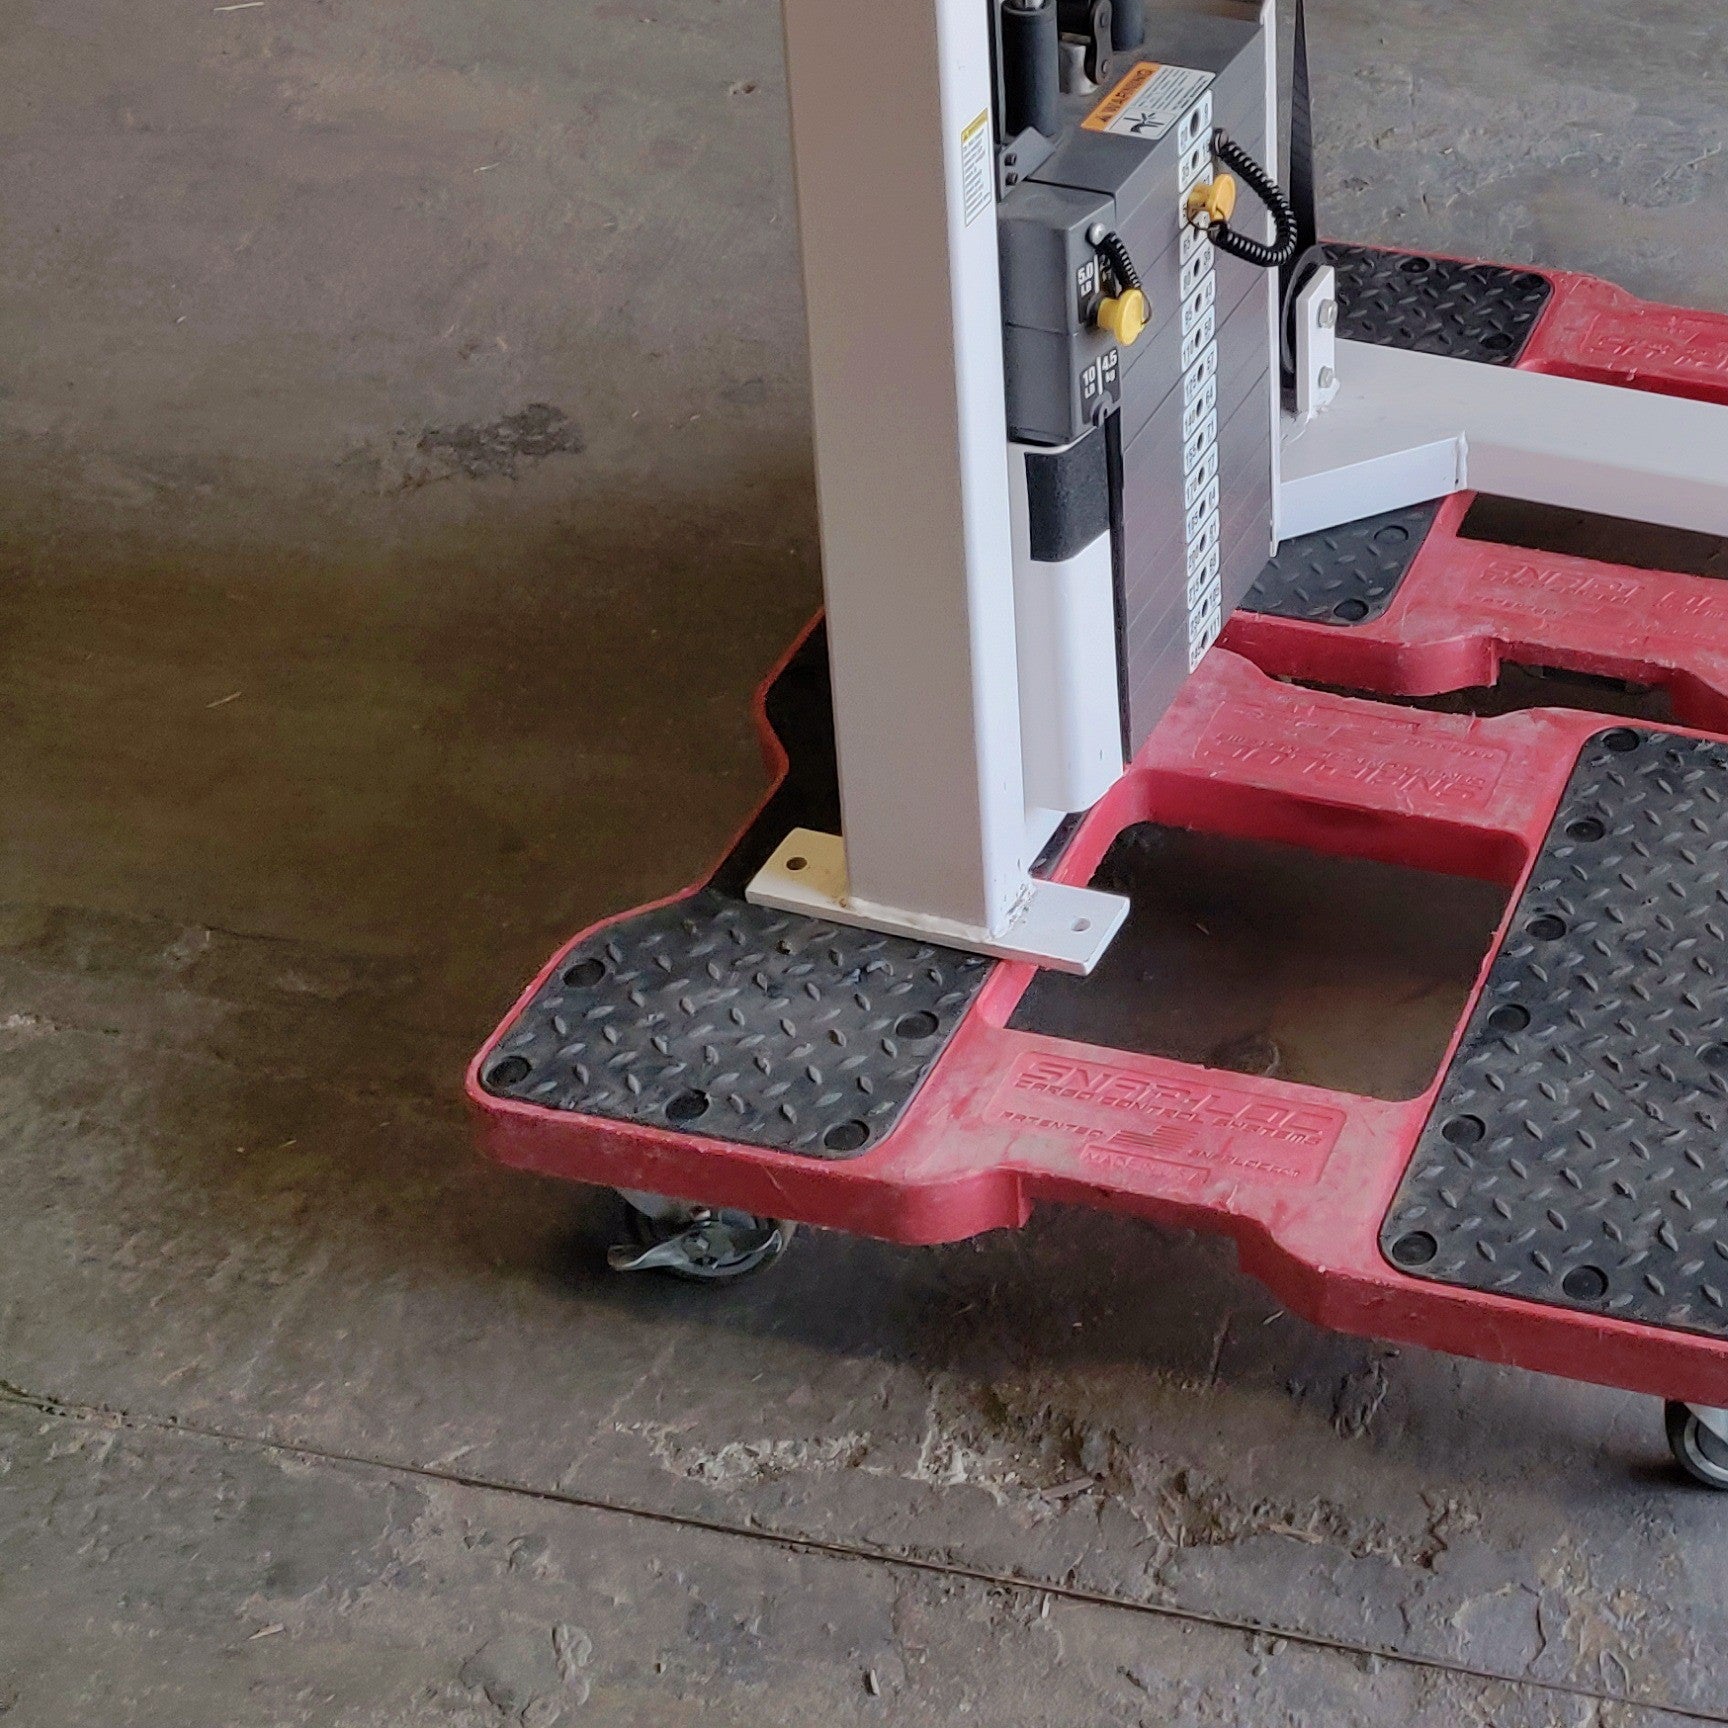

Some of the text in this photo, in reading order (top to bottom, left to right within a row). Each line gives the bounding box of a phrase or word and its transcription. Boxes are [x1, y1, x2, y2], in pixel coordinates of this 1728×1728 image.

[1078, 262, 1094, 285] 5.0
[1080, 281, 1092, 298] LB
[1082, 349, 1118, 386] 10 4.5
[1084, 382, 1096, 399] LB
[1014, 1073, 1324, 1145] CARGO CONTROL SYSTEMS
[1000, 1110, 1104, 1137] PATENTED
